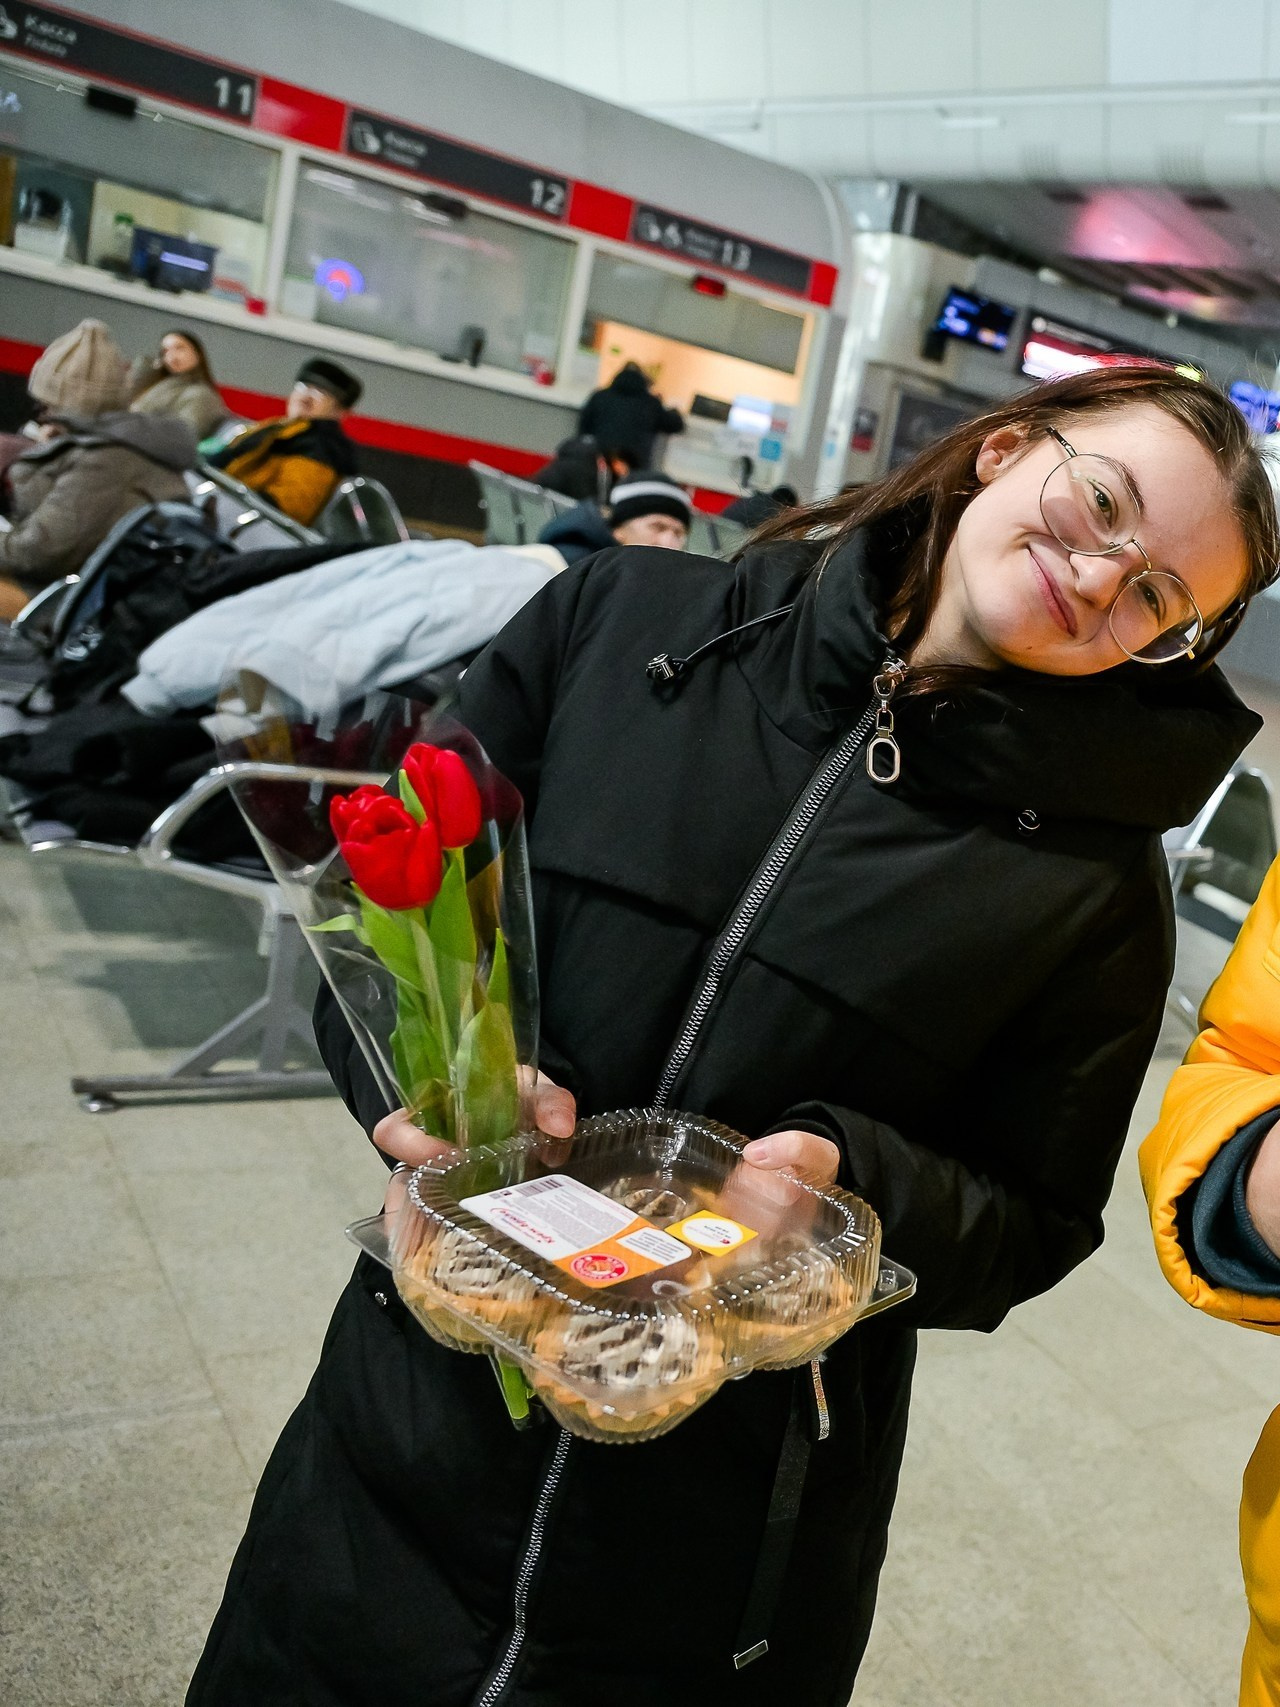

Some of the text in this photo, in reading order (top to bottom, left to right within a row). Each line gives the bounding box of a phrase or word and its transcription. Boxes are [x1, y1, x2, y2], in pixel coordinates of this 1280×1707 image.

[25, 14, 77, 45] Касса
[214, 76, 252, 114] 11
[530, 178, 565, 215] 12
[722, 239, 751, 271] 13
